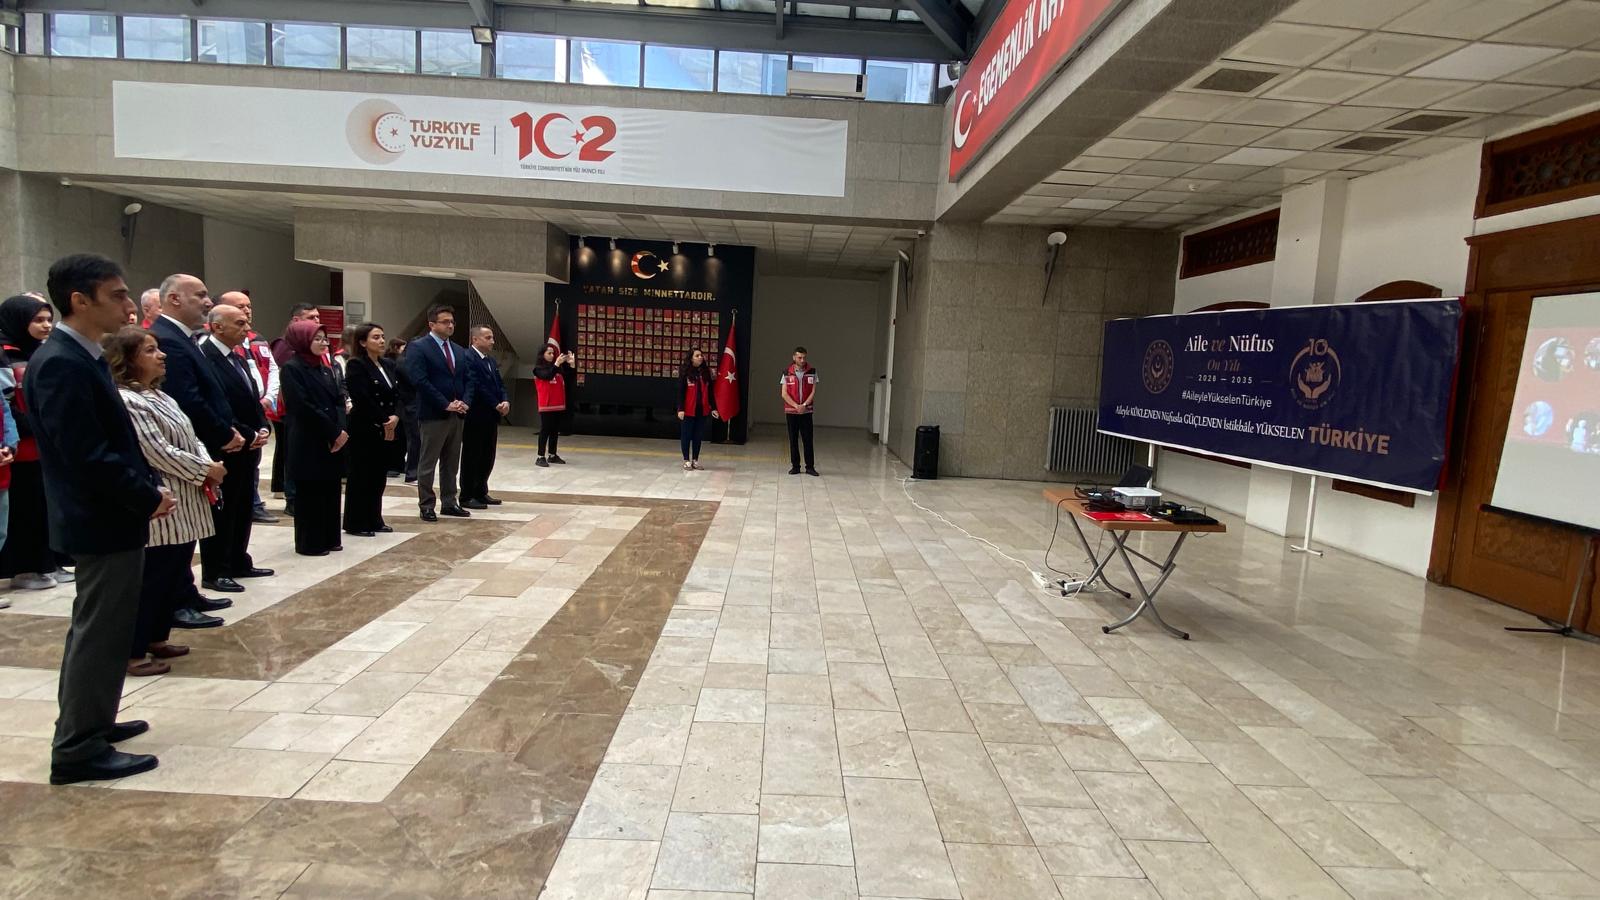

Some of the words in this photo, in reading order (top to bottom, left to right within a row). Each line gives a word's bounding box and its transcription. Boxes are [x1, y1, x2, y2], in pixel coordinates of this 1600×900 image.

[410, 119, 480, 135] TÜRKİYE
[410, 134, 474, 151] YÜZYILI
[1183, 334, 1209, 352] Aile
[1211, 340, 1226, 352] ve
[1228, 333, 1275, 352] Nüfus
[1231, 376, 1253, 384] 2035
[1183, 413, 1222, 429] GÜÇLENEN
[1255, 422, 1305, 440] YÜKSELEN
[1308, 422, 1391, 455] TÜRKİYE
